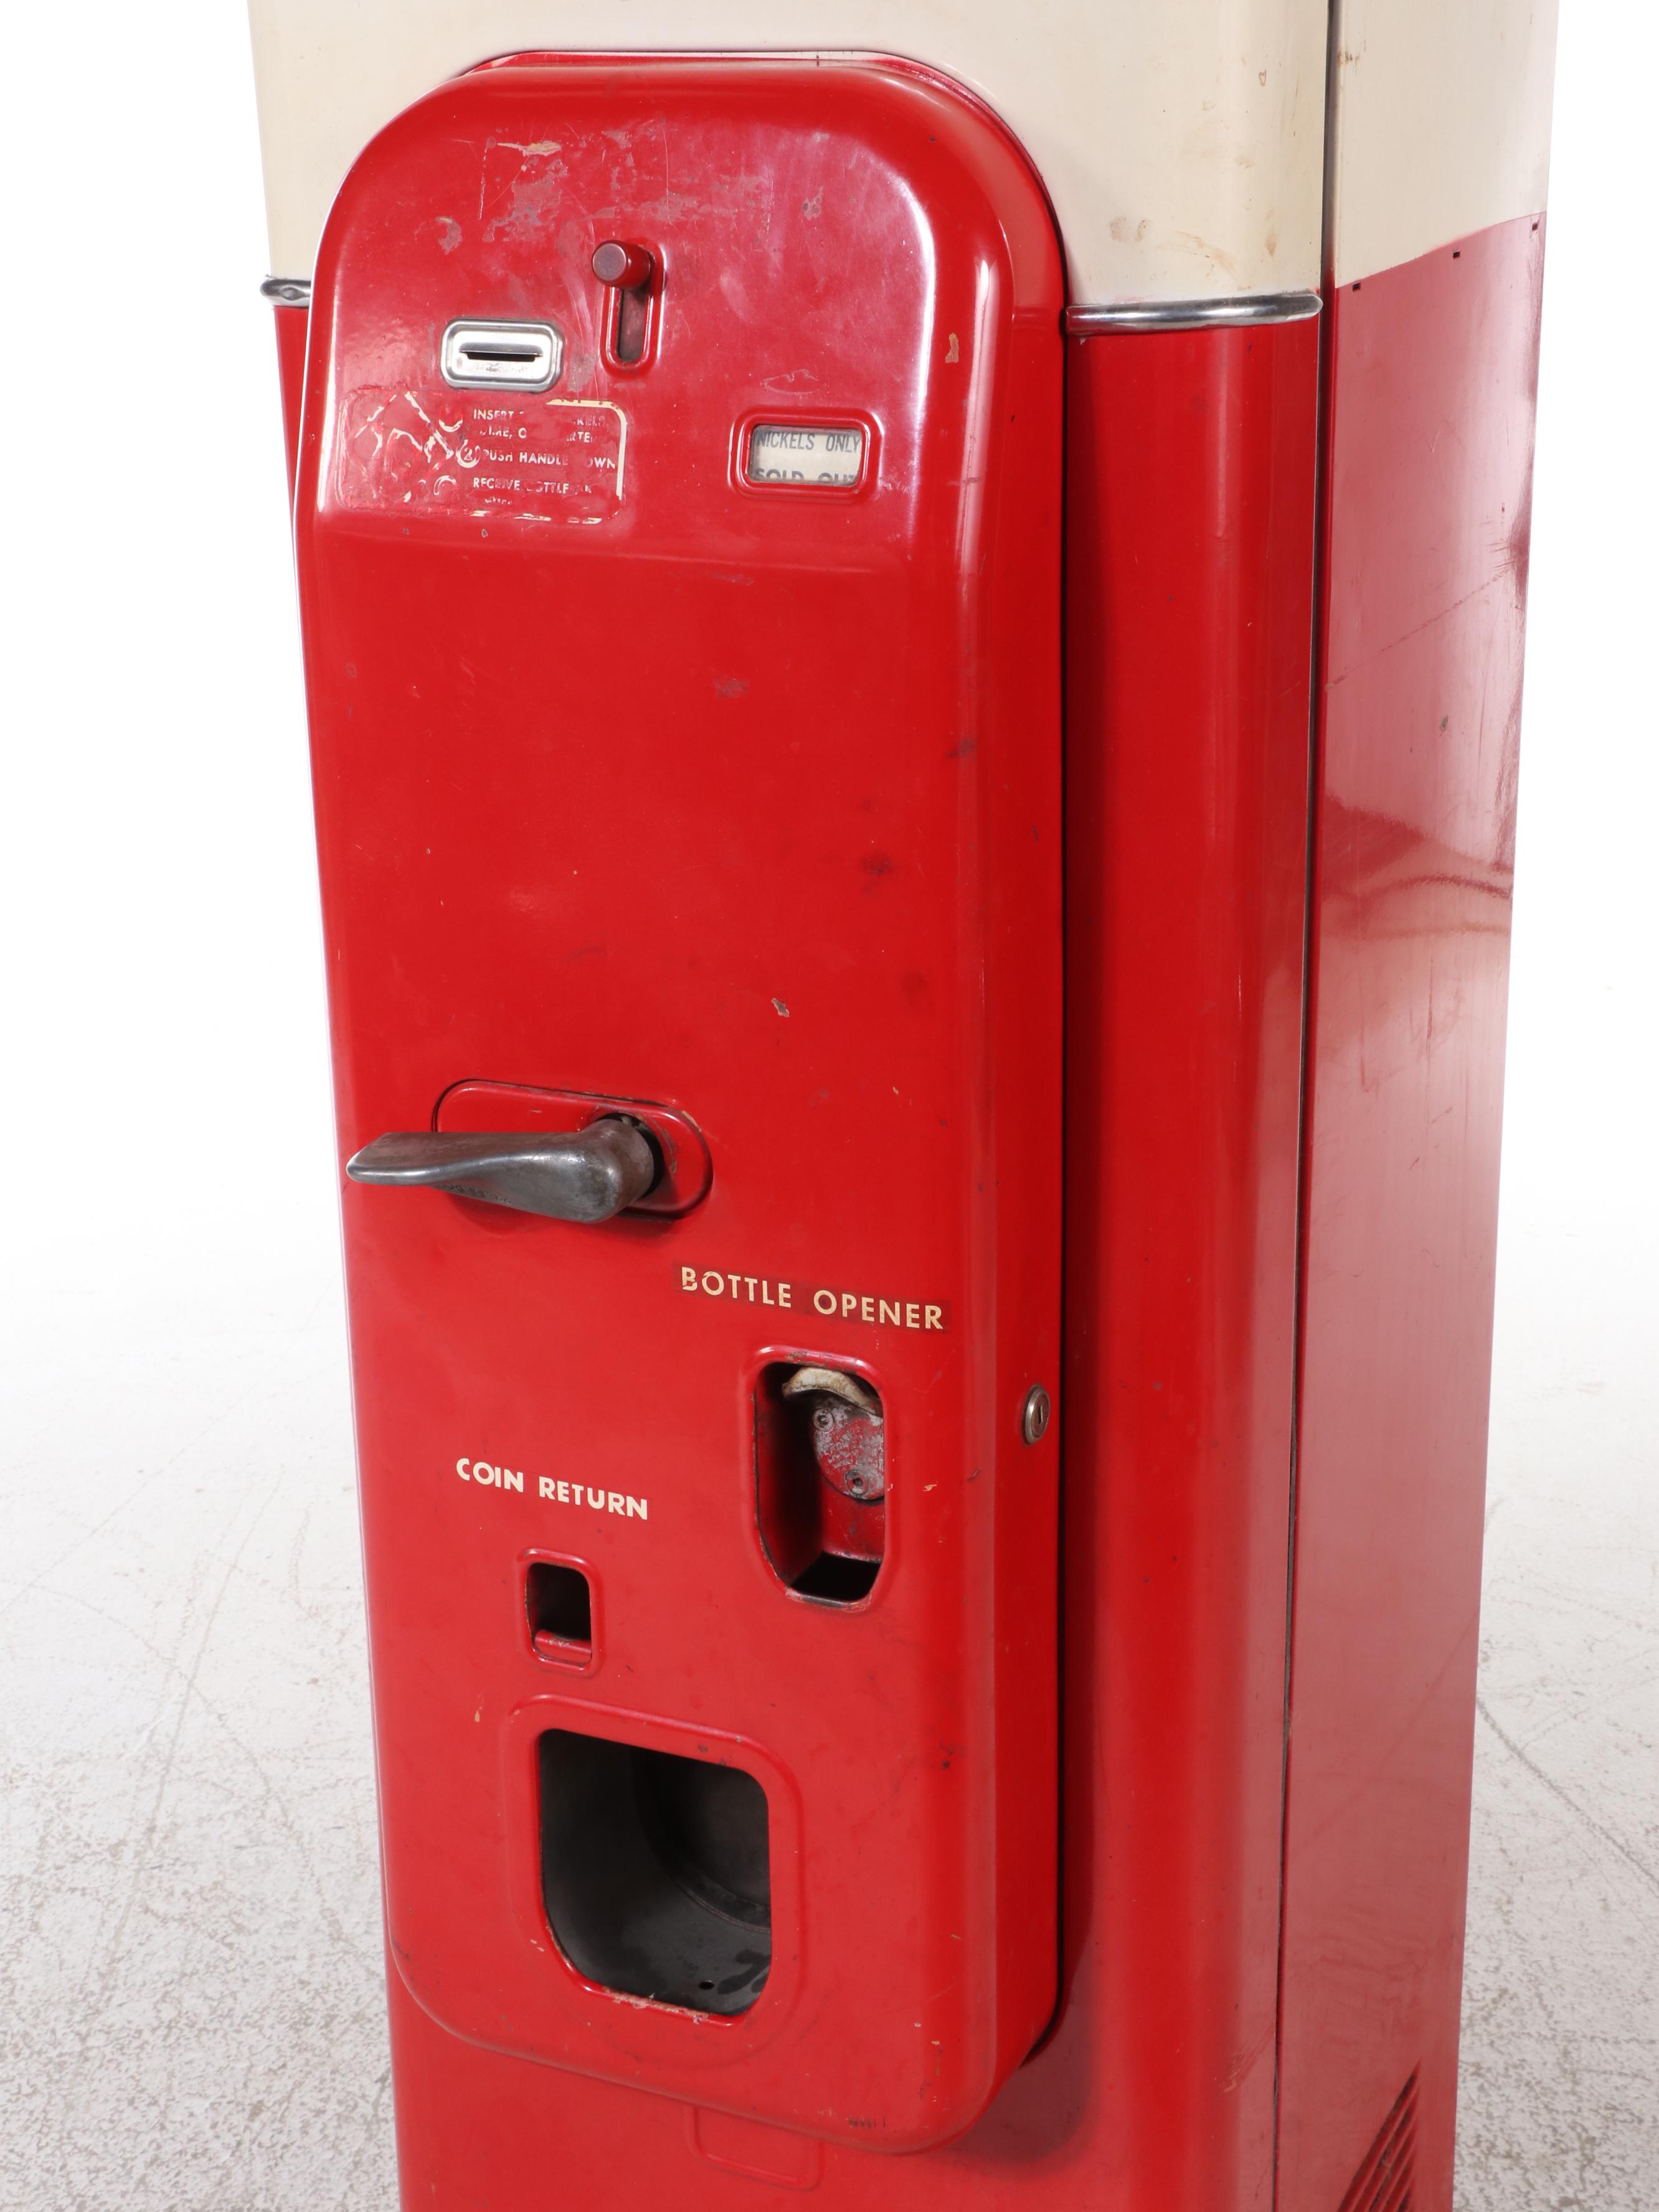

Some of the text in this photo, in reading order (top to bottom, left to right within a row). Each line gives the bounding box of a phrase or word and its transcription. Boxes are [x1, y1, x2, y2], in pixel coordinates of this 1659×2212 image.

[519, 452, 569, 466] HANDLE
[755, 430, 859, 453] NICKELS ONLY
[681, 1266, 943, 1330] BOTTLE OPENER
[456, 1457, 648, 1520] COIN RETURN
